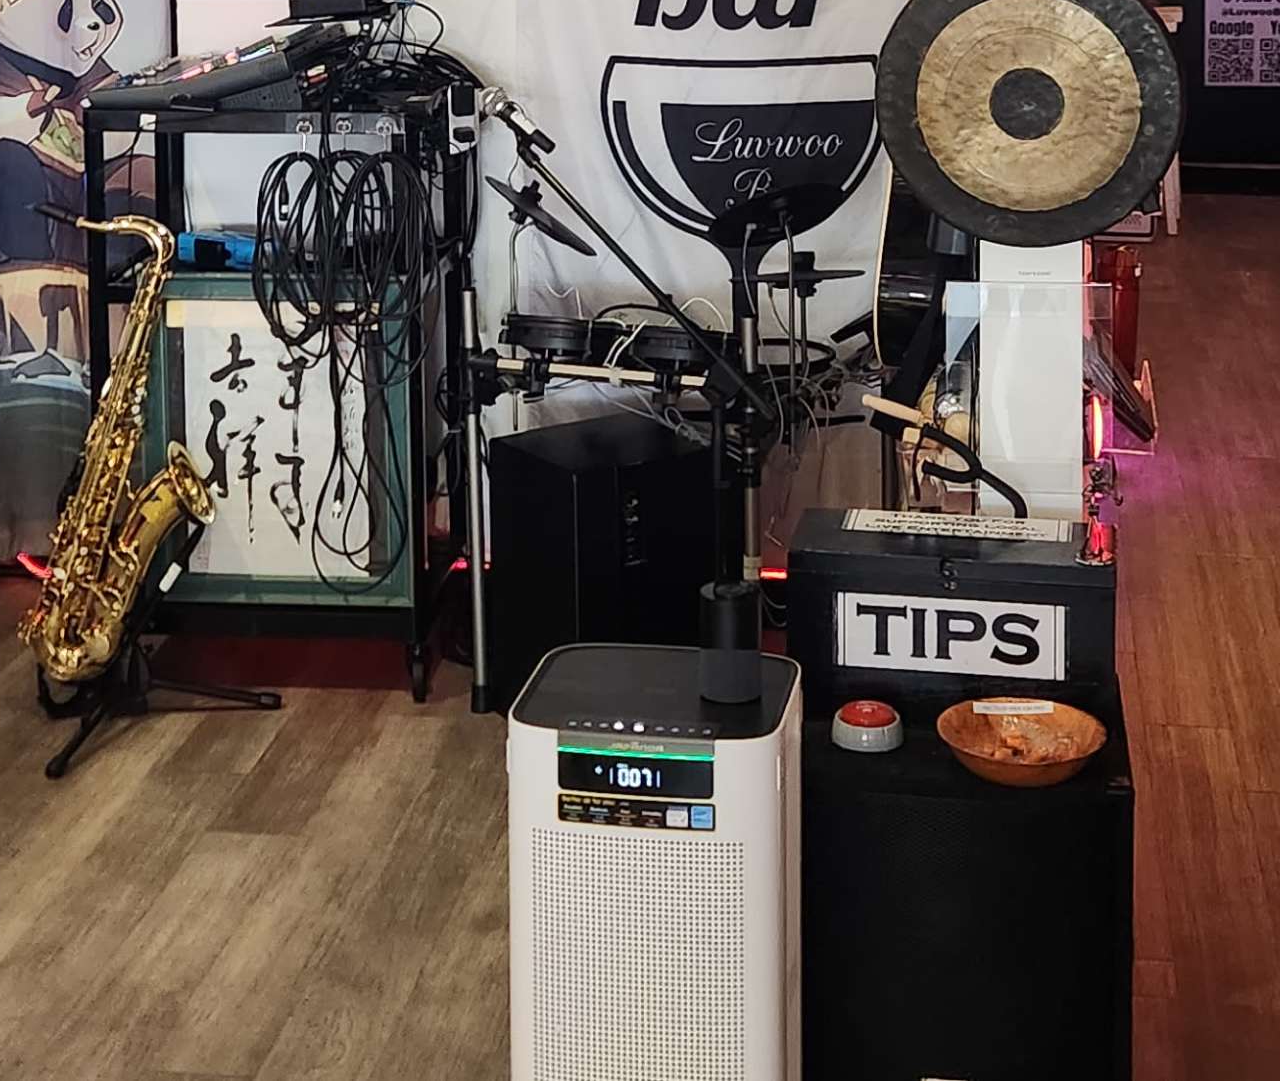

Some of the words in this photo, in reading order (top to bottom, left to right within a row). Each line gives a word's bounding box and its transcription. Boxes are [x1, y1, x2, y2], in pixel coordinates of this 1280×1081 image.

[1209, 20, 1254, 36] Google
[692, 118, 842, 162] Luvwoo
[866, 523, 906, 532] LIVE
[908, 525, 1047, 538] ENTERTAINMENT
[984, 523, 1040, 532] LOCAL
[856, 602, 1041, 665] TIPS
